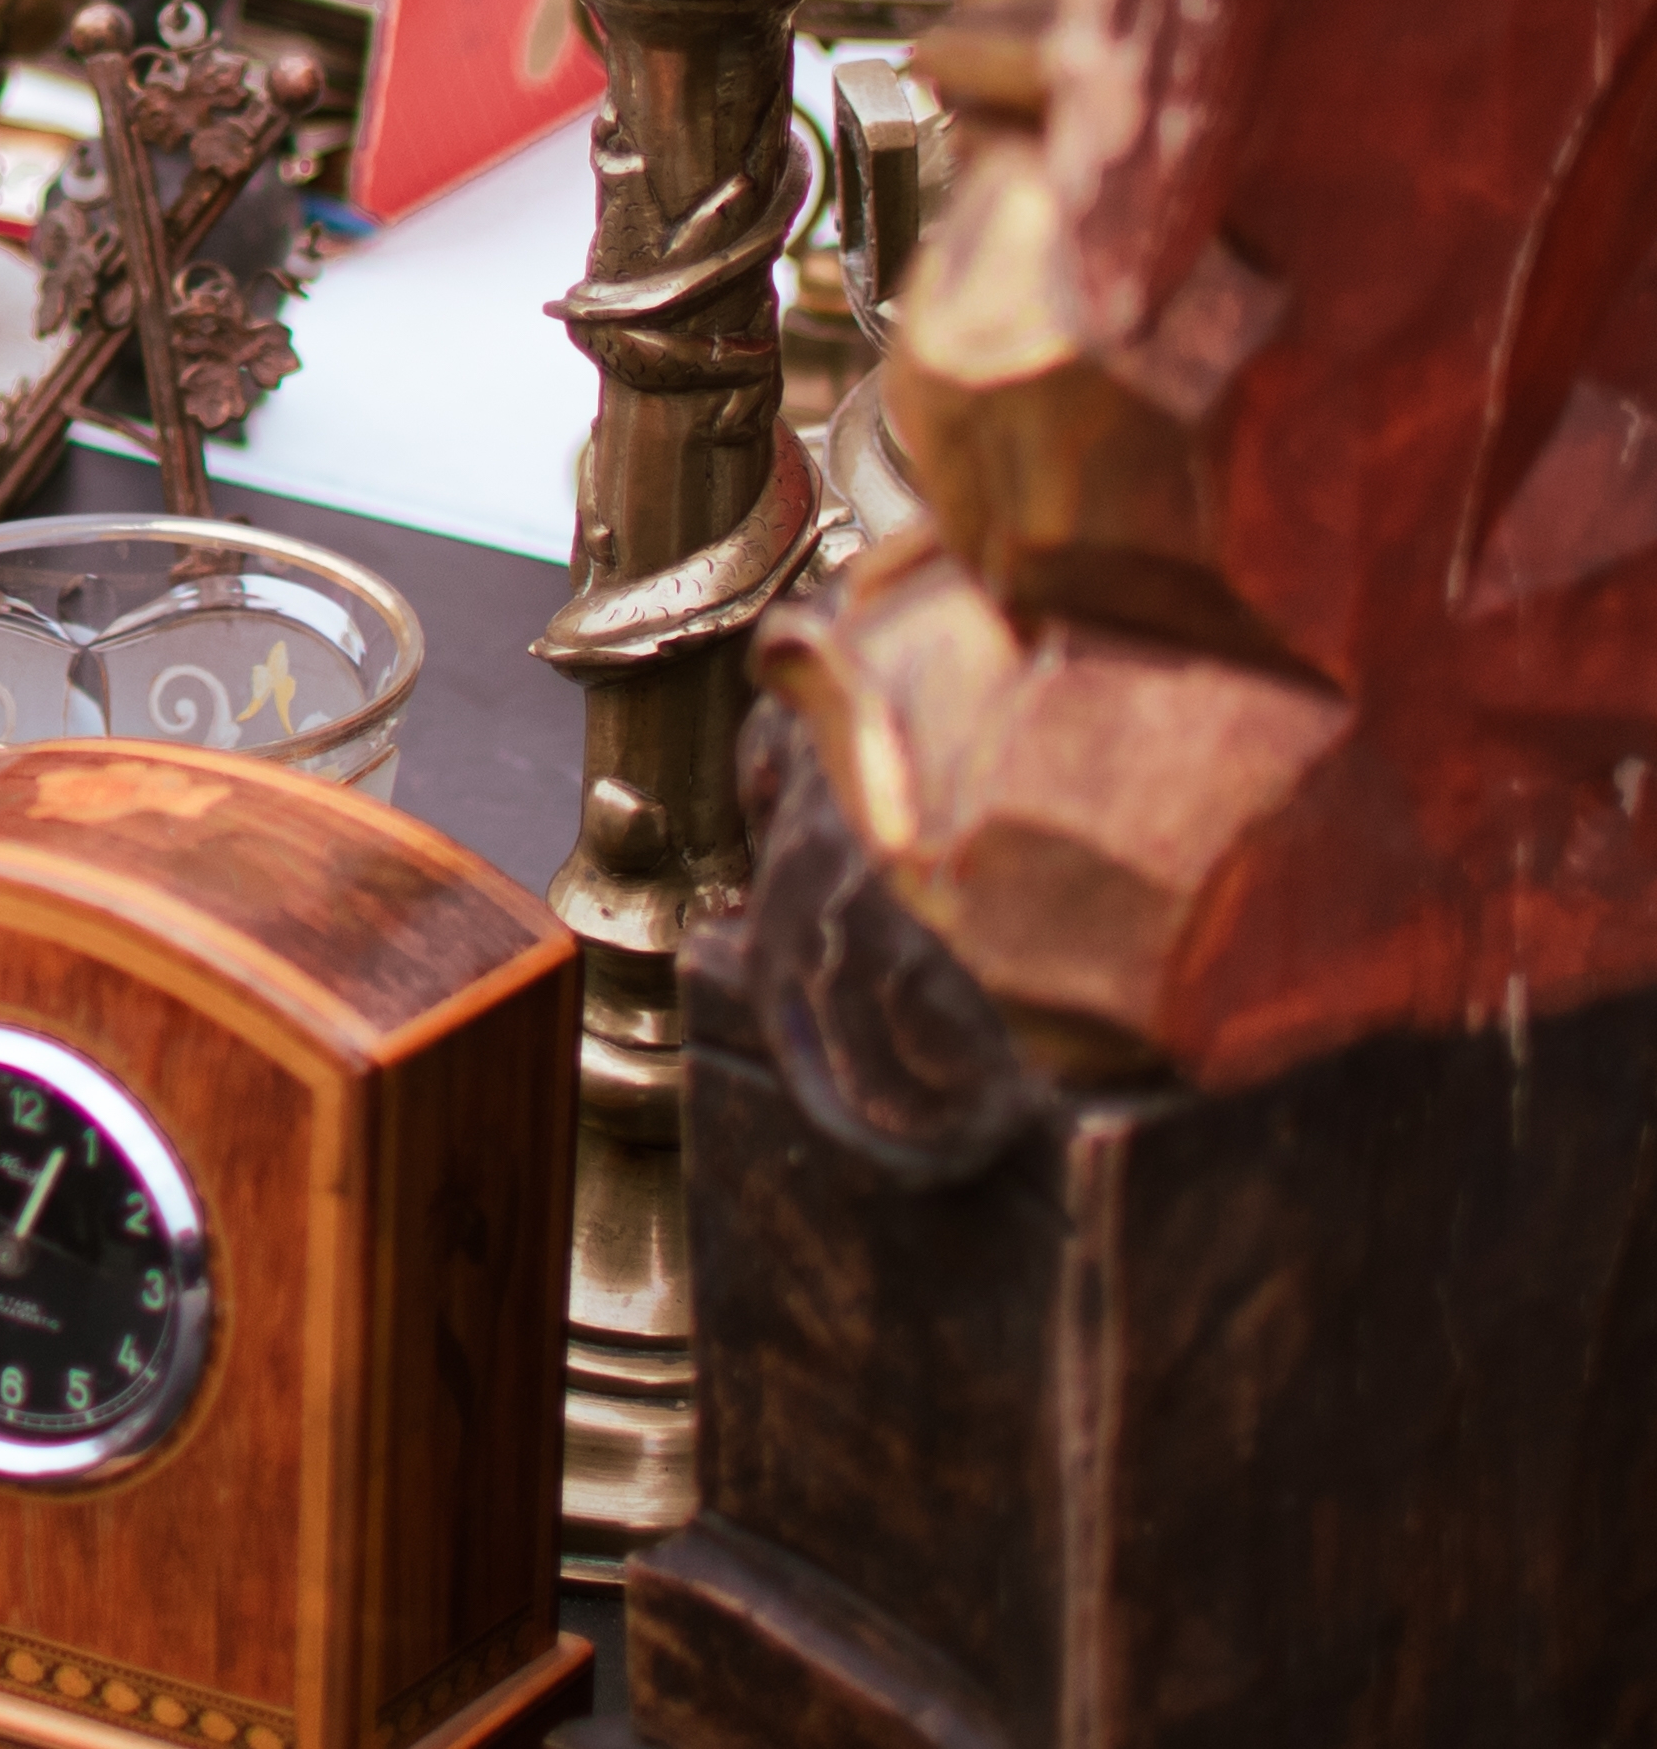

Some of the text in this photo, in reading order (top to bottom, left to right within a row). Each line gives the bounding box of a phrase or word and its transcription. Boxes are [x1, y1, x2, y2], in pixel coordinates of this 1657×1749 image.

[11, 1087, 46, 1132] 12
[84, 1128, 98, 1166] 1
[125, 1192, 151, 1236] 2
[142, 1269, 165, 1309] 3
[117, 1334, 142, 1375] 4
[0, 1367, 25, 1405] 6
[67, 1368, 91, 1409] 5
